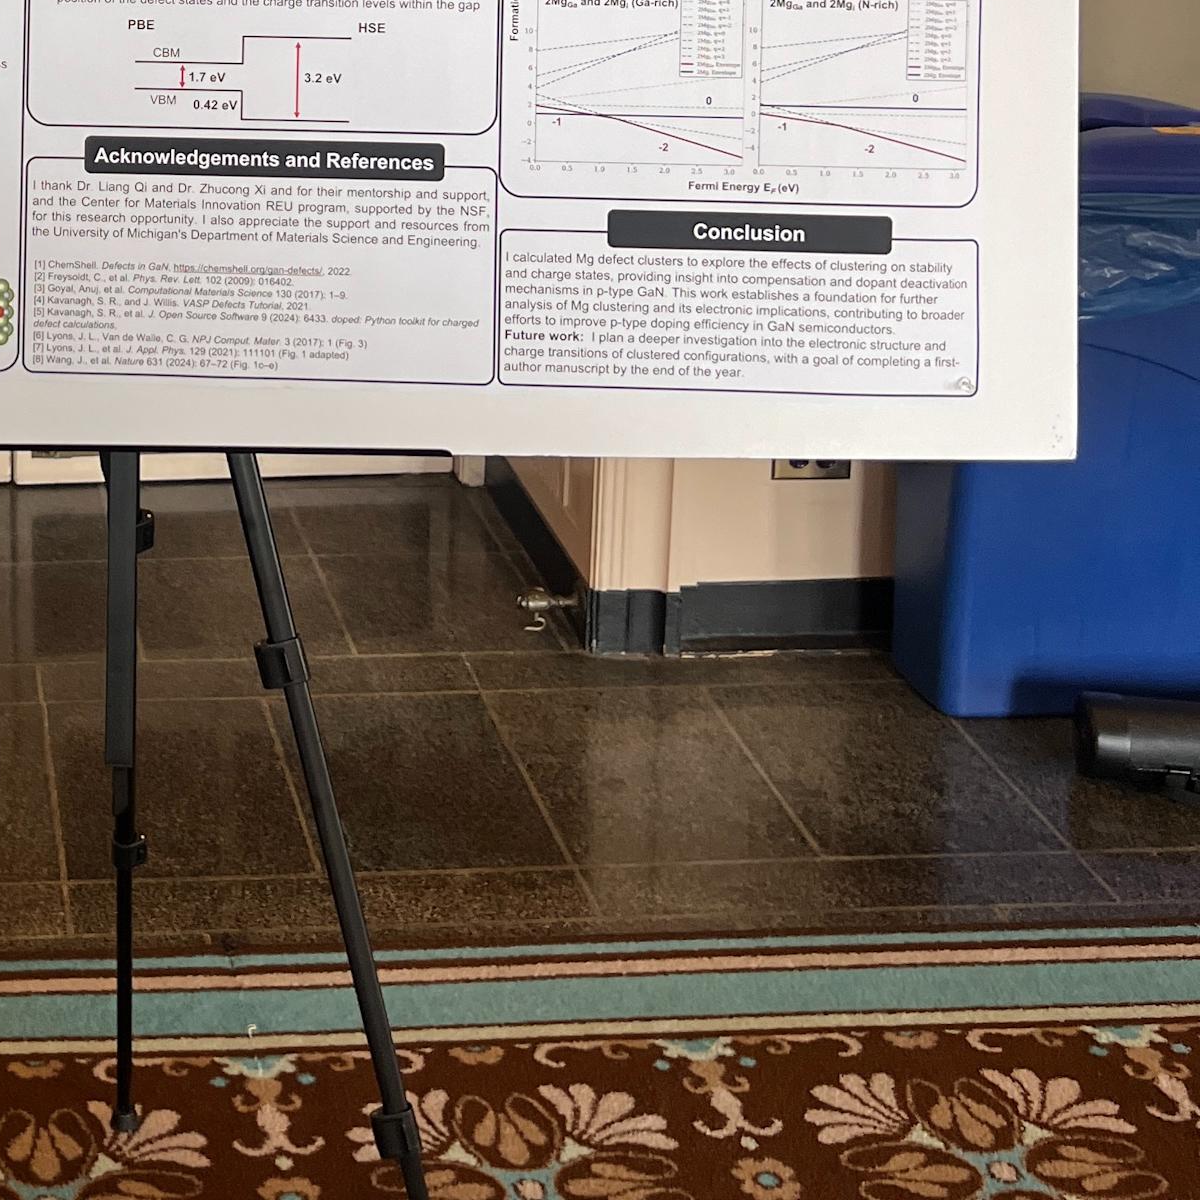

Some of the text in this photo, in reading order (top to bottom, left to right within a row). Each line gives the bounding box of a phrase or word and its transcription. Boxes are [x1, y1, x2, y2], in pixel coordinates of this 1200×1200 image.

[128, 19, 154, 30] PBE
[358, 22, 385, 33] HSE
[152, 47, 179, 58] CBM
[188, 71, 225, 82] 1.7 eV
[304, 72, 342, 84] 3.2 eV
[150, 94, 176, 105] VBM
[193, 99, 237, 110] 0.42 eV
[93, 147, 434, 171] Acknowledgements and References
[31, 225, 480, 250] the University of Michigan's Department of Materials Science and Engineering.
[692, 222, 805, 242] Conclusion
[504, 329, 946, 351] Future work: I plan a deeper investigation into the electronic structure and
